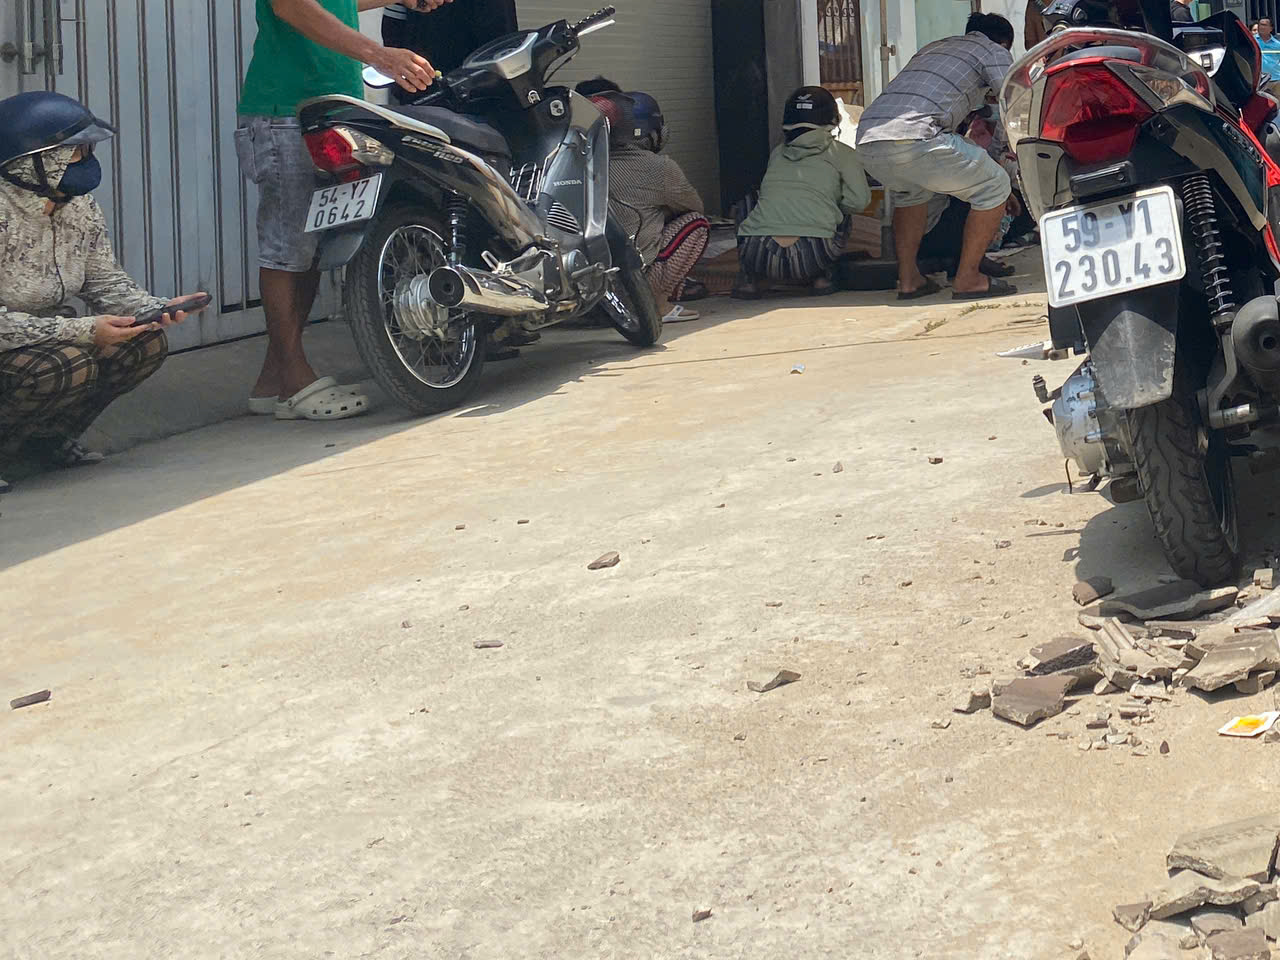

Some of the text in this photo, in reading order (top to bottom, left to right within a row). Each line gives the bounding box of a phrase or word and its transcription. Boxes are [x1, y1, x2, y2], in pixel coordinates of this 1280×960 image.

[318, 179, 370, 208] 54-Y7
[553, 179, 583, 187] HONDA
[314, 200, 365, 228] 0642
[1062, 199, 1153, 253] 59-Y1
[1055, 237, 1173, 300] 230.43
